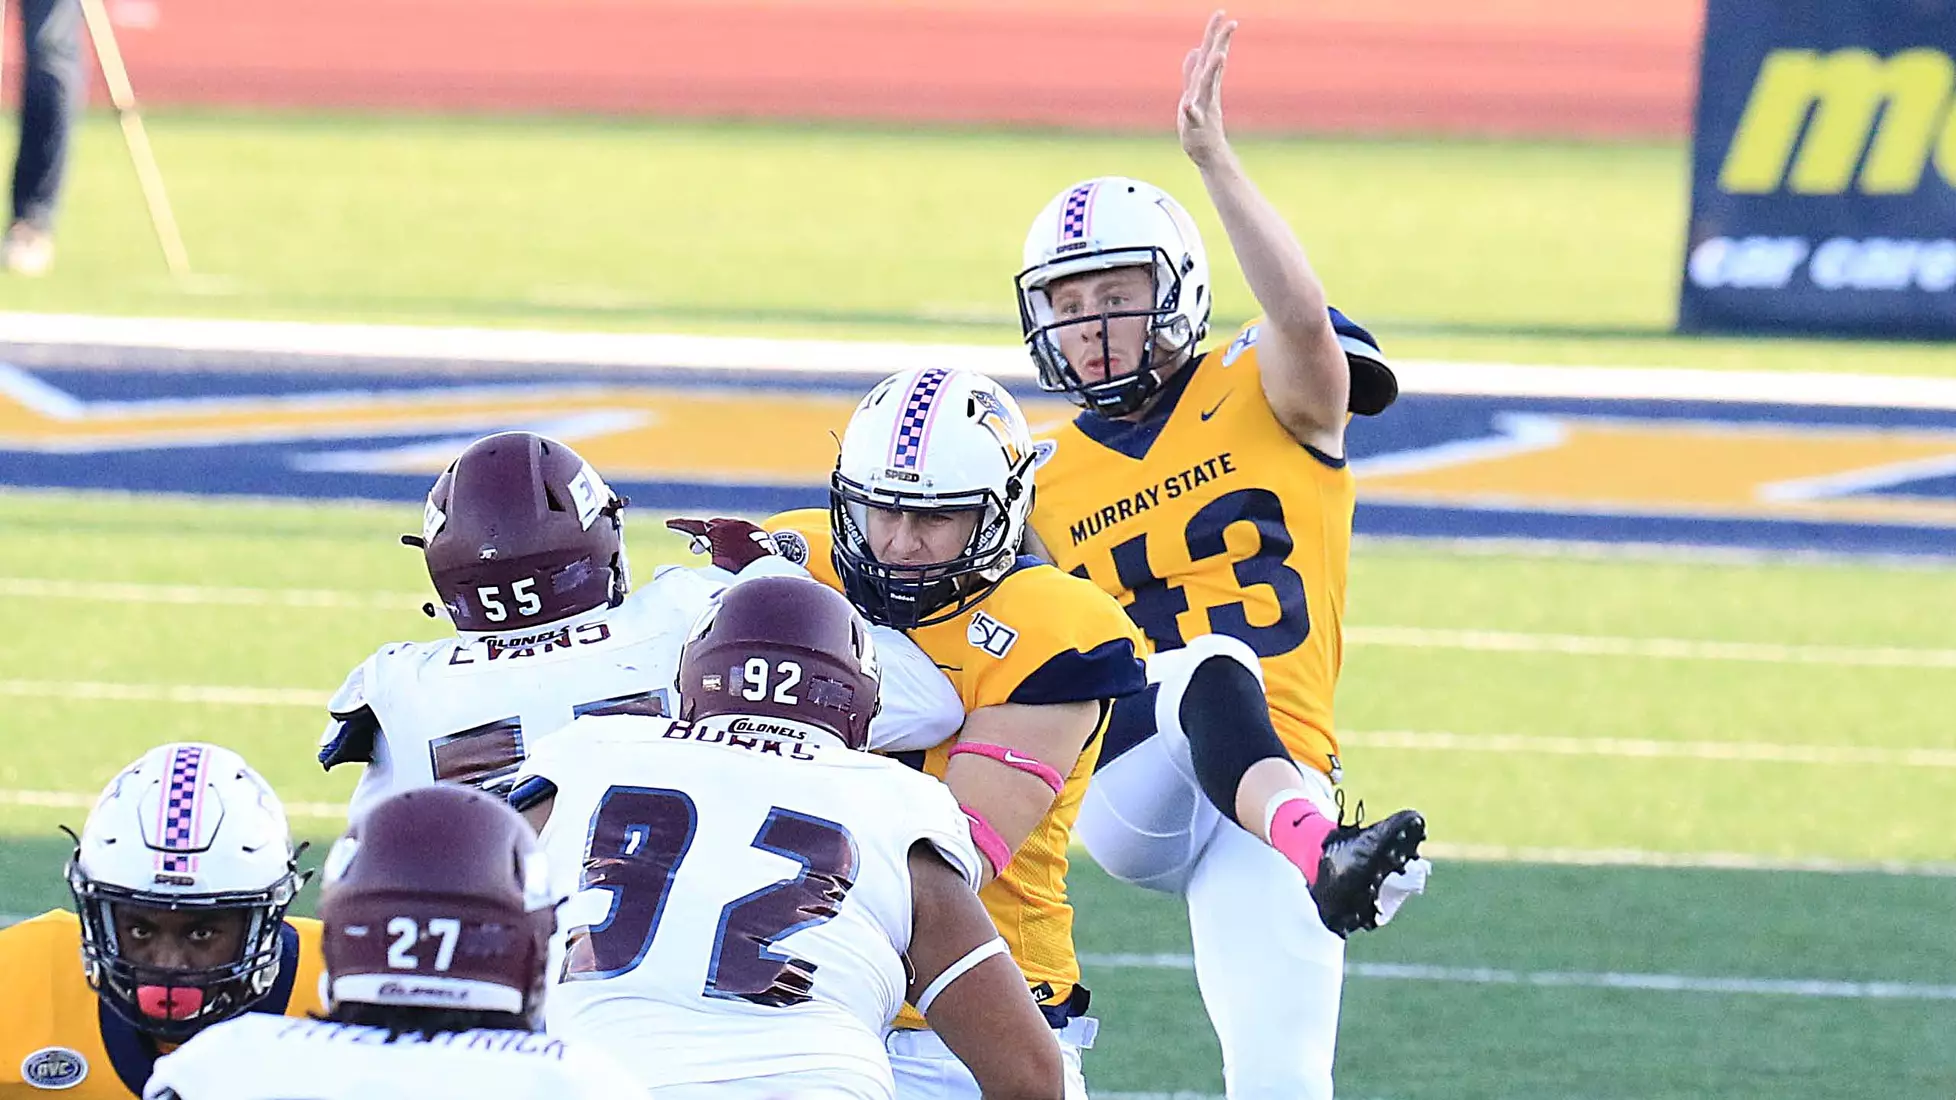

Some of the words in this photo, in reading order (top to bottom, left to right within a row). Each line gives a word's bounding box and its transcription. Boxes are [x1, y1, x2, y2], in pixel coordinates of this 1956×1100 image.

[1717, 46, 1956, 195] m
[1688, 236, 1808, 289] car
[885, 469, 920, 482] SPEED
[1069, 484, 1159, 547] MURRAY
[1164, 453, 1236, 500] STATE
[477, 577, 542, 622] 55
[1069, 487, 1311, 658] 43
[742, 657, 803, 705] 92
[728, 717, 808, 741] COLONELS
[558, 784, 861, 1008] 92
[386, 916, 462, 972] 27
